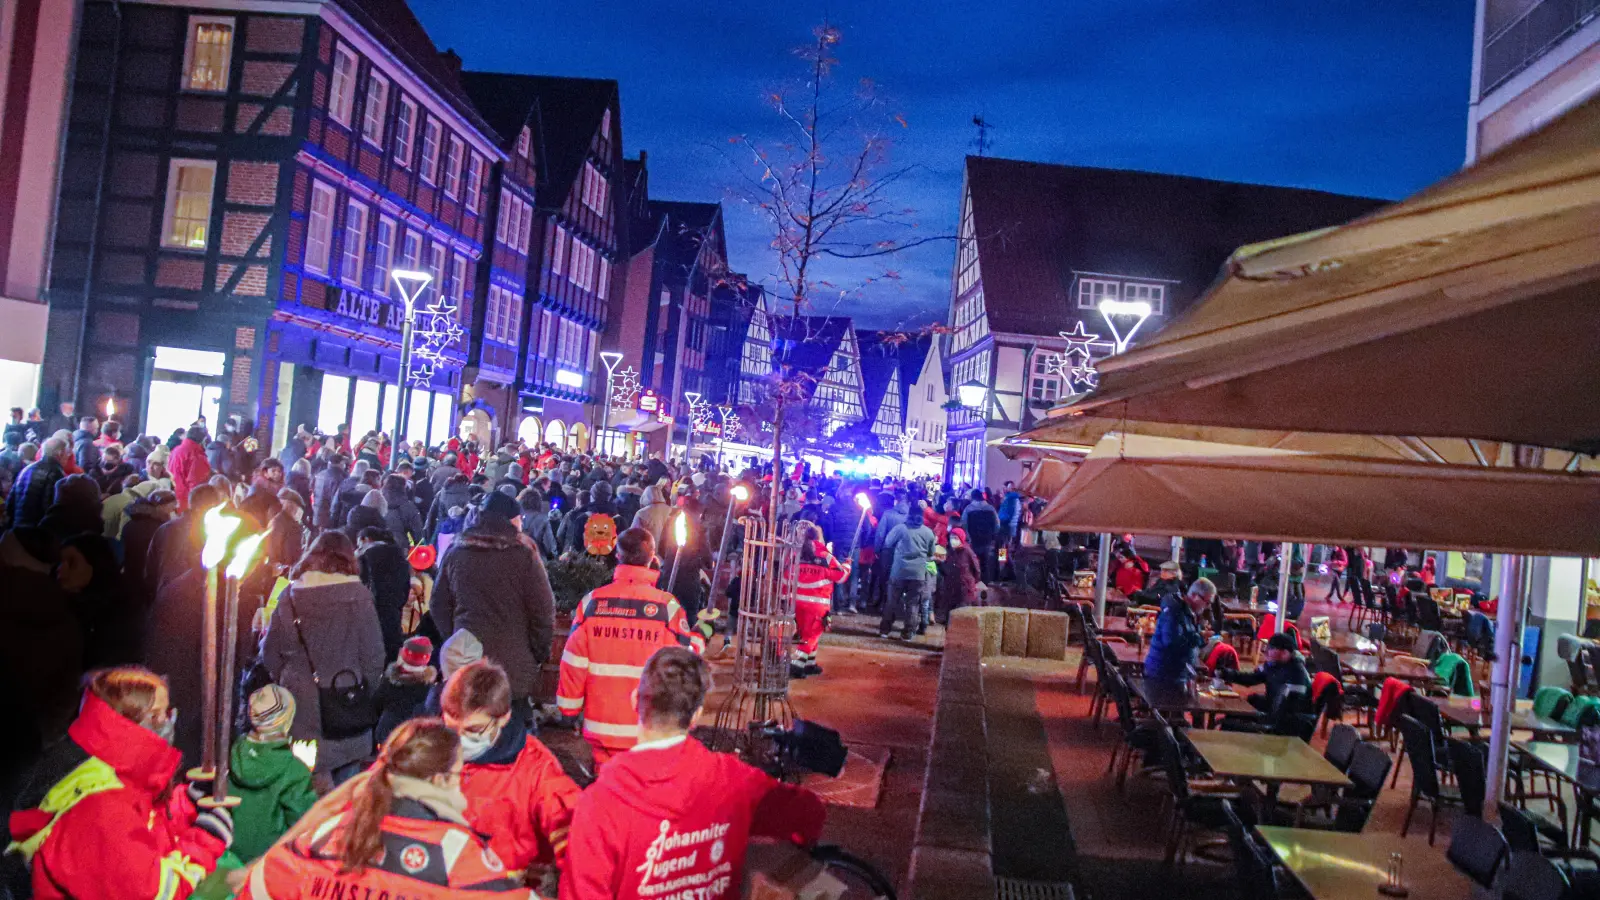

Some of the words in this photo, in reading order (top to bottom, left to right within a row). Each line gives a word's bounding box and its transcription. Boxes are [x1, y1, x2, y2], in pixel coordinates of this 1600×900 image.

[336, 288, 380, 324] ALTE
[593, 626, 660, 642] WUNSTORF
[651, 819, 731, 860] Johanniter
[636, 847, 698, 885] Jugend
